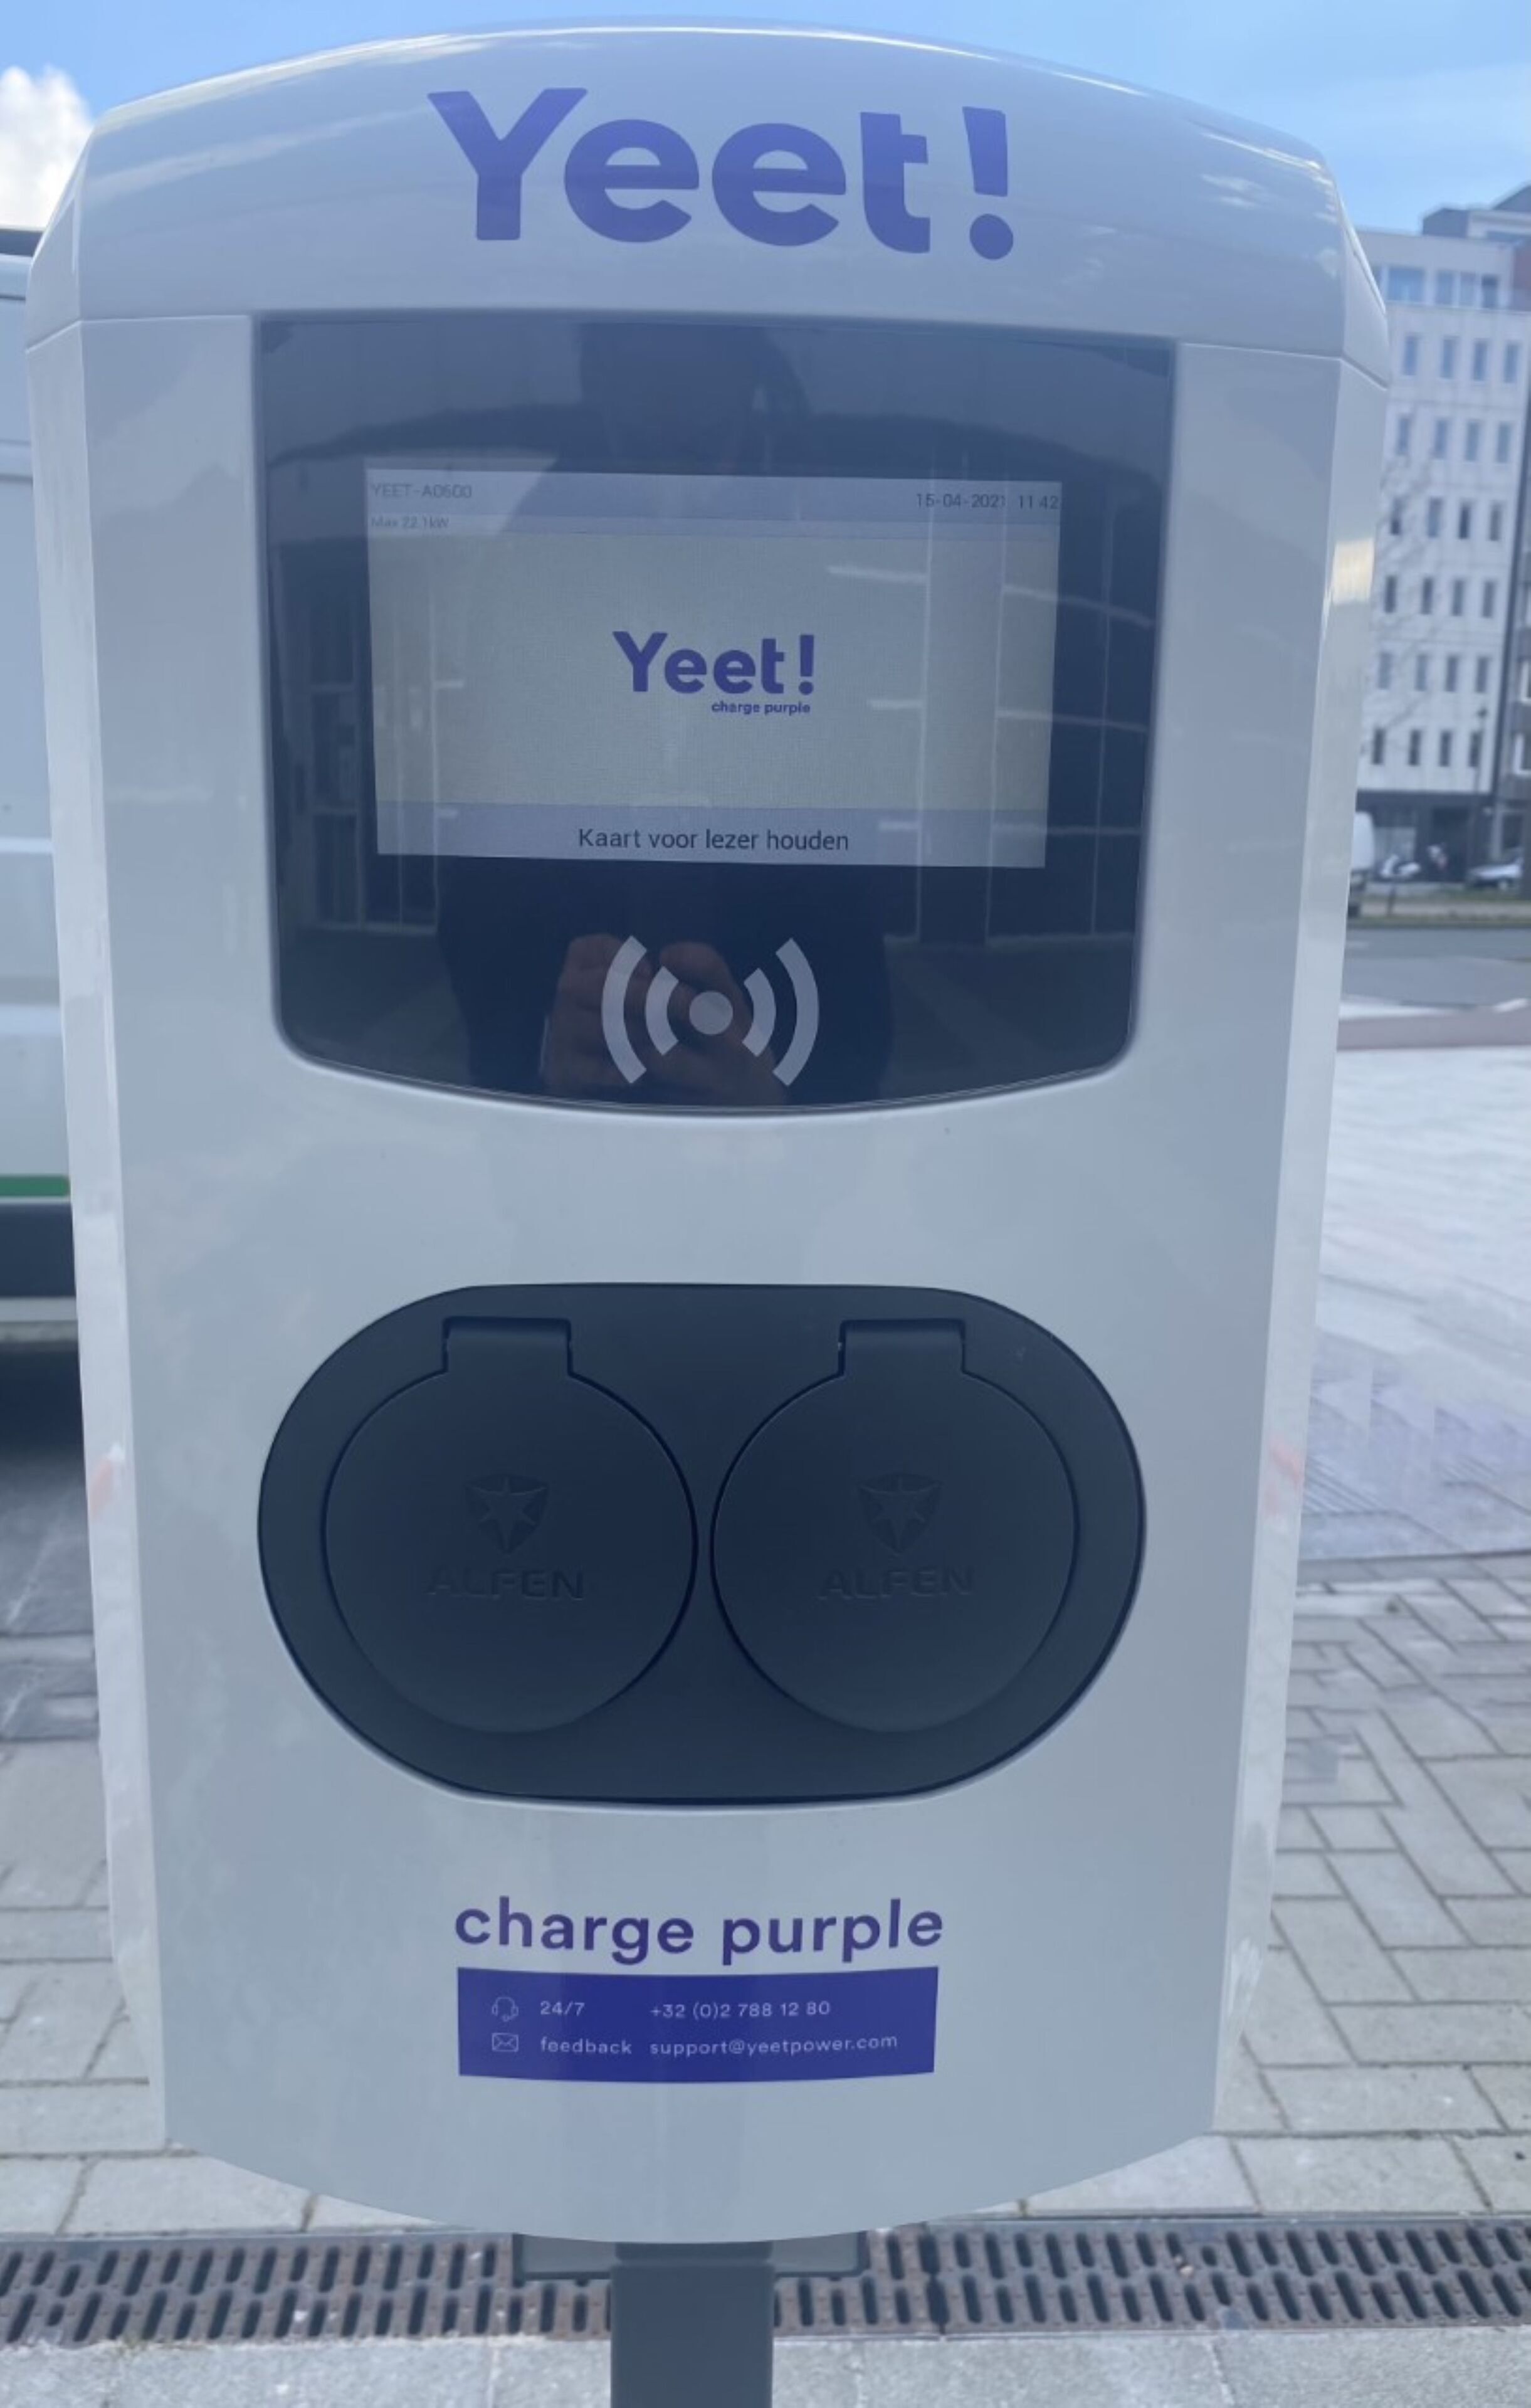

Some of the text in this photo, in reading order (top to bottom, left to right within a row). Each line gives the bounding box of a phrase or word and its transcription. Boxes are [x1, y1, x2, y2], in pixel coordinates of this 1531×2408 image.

[427, 87, 1014, 260] Yeet!
[916, 493, 1007, 509] 15-04-2021
[612, 631, 814, 695] Yeet!
[711, 700, 811, 716] charge purple
[579, 828, 849, 850] Kaart voor lezer houden
[425, 1568, 584, 1601] ALFEN
[816, 1566, 976, 1600] ALFEN
[455, 1896, 943, 1966] charge purple
[540, 2000, 585, 2016] 24/7
[650, 2000, 831, 2020] +32 (0)2 788 12 80
[540, 2036, 632, 2054] feedback
[650, 2036, 898, 2057] support@yeetpower.com
